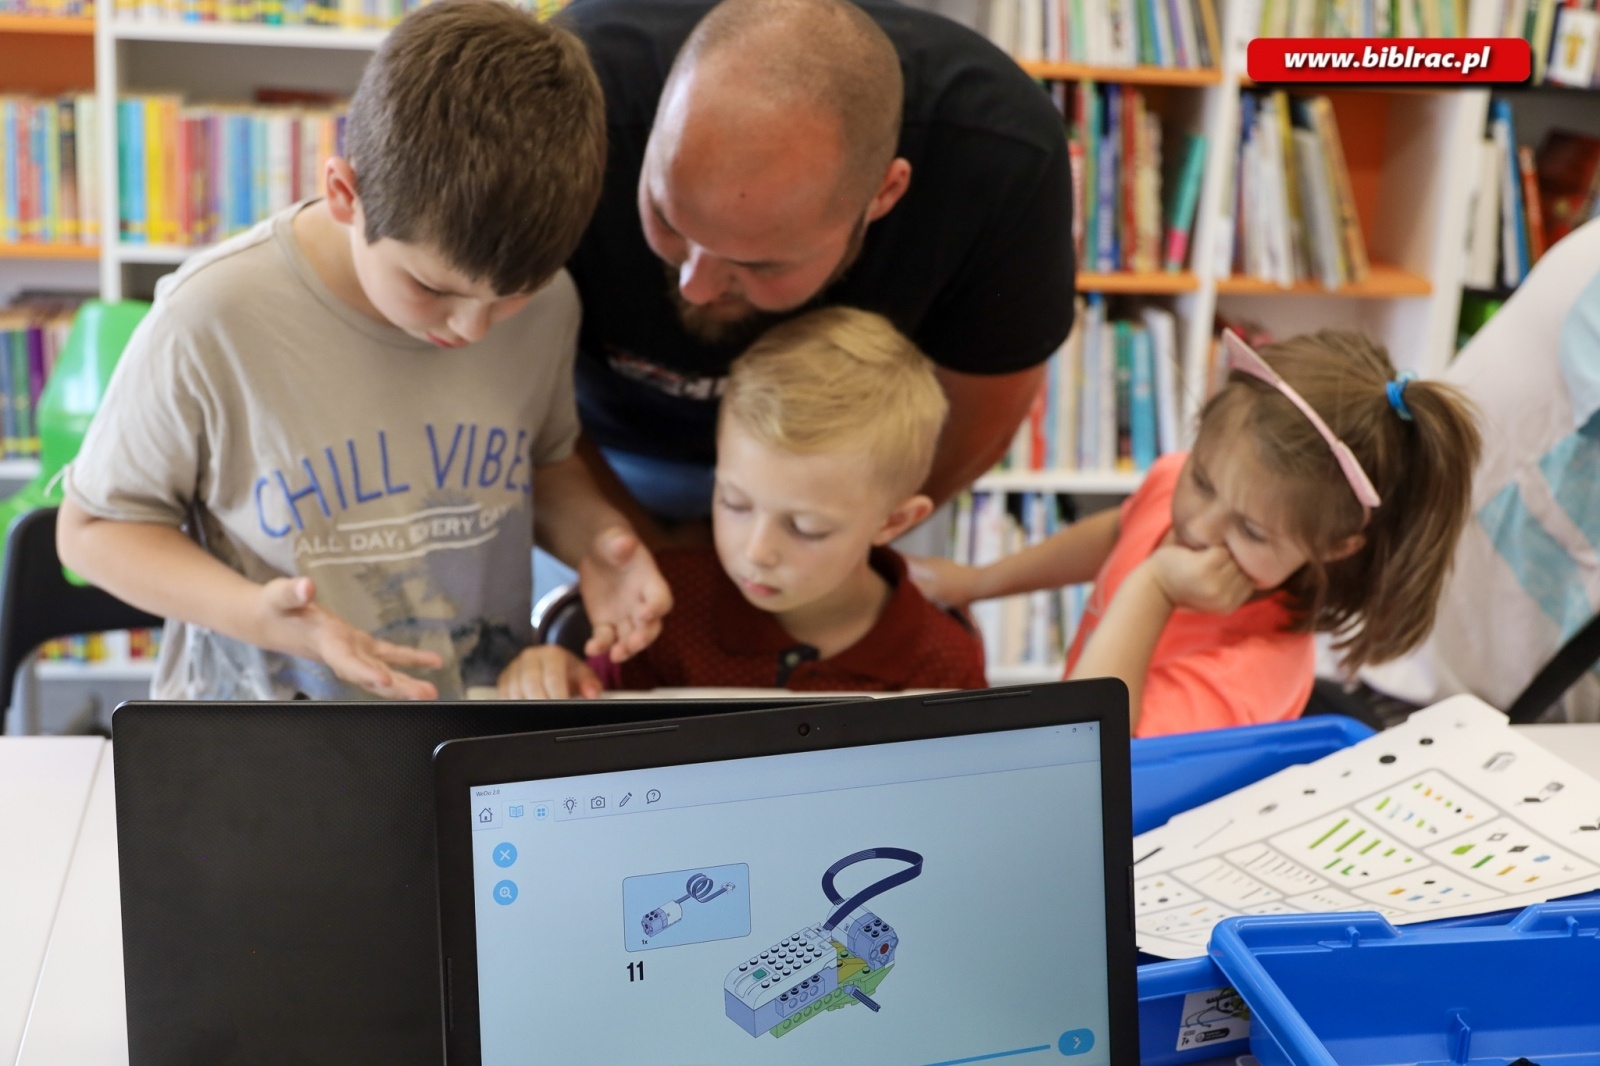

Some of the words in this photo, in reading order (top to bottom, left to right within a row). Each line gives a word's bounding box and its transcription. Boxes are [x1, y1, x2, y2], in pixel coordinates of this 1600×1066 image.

[254, 430, 411, 538] CHILL
[294, 532, 345, 557] ALL
[350, 529, 405, 551] DAY,
[410, 516, 475, 543] EVERY
[626, 960, 645, 982] 11
